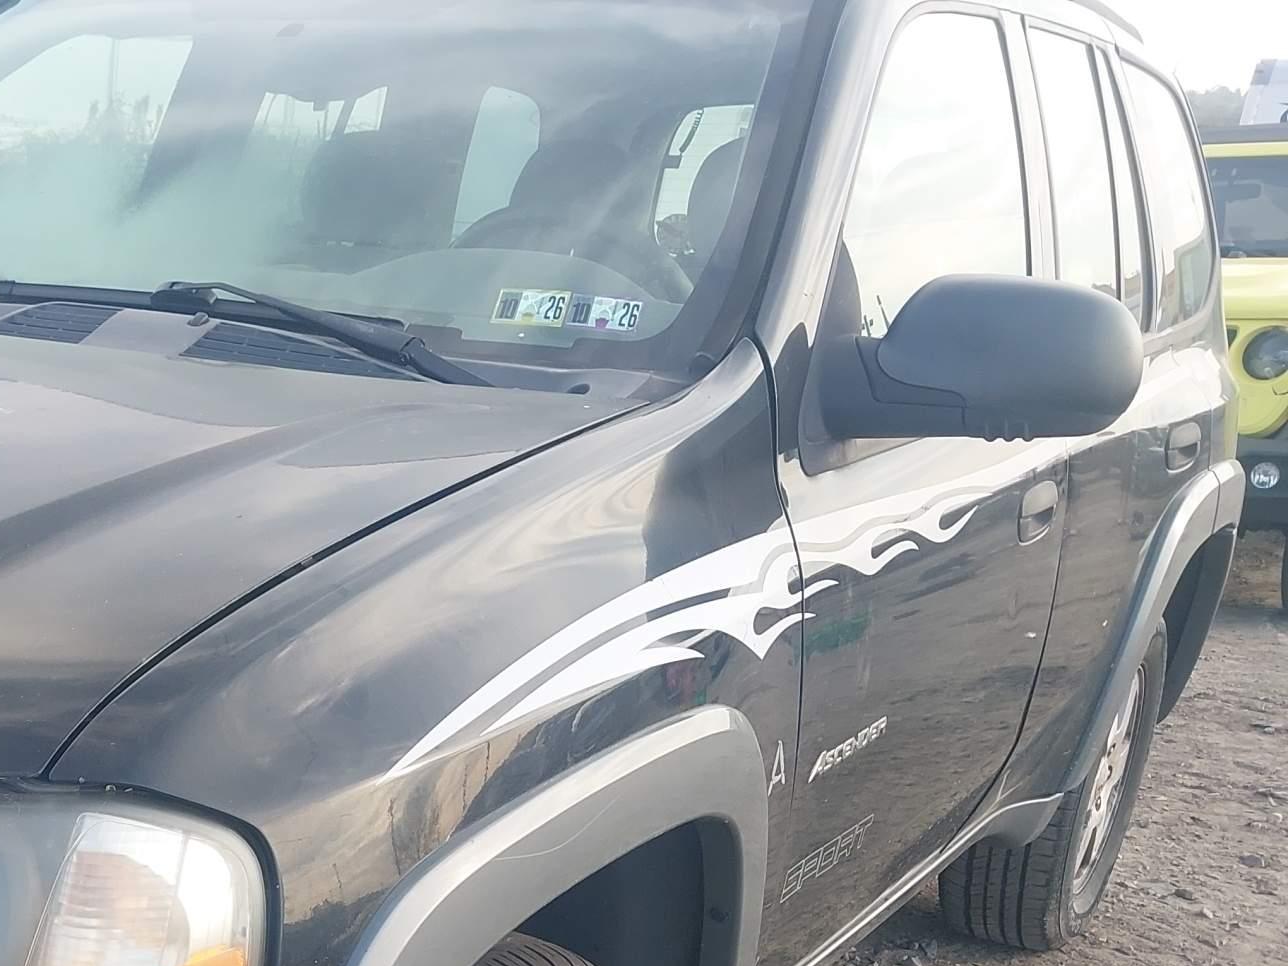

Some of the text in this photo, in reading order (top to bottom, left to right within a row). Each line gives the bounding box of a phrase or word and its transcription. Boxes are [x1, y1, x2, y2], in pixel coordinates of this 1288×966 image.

[544, 295, 566, 320] 26
[571, 302, 641, 328] 10 26
[808, 716, 888, 784] ASCENDER
[779, 813, 875, 904] SPORT
